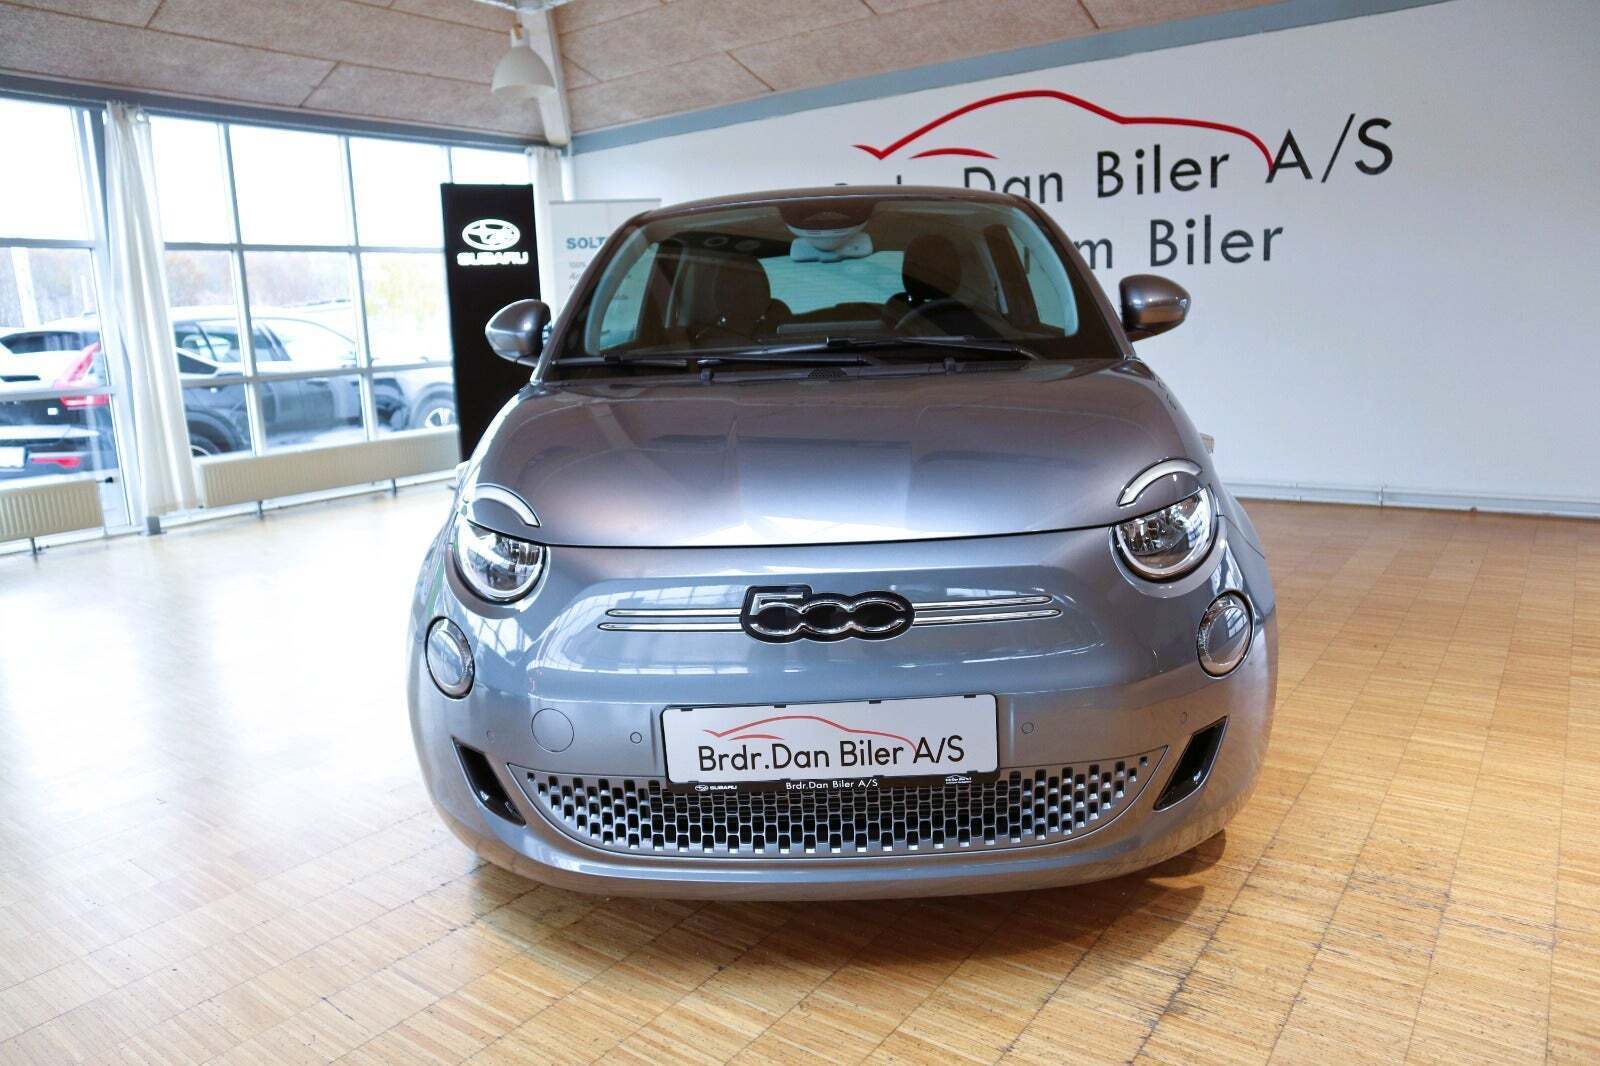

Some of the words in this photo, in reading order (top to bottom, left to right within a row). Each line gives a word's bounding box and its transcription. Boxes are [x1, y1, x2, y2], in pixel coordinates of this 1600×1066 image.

[1096, 143, 1230, 198] Biler
[1264, 112, 1394, 184] A/S
[1150, 213, 1284, 267] Biler
[746, 588, 911, 639] 500
[839, 739, 904, 767] Biler
[912, 735, 965, 764] A/S
[832, 779, 854, 788] Biler
[858, 778, 878, 788] A/S
